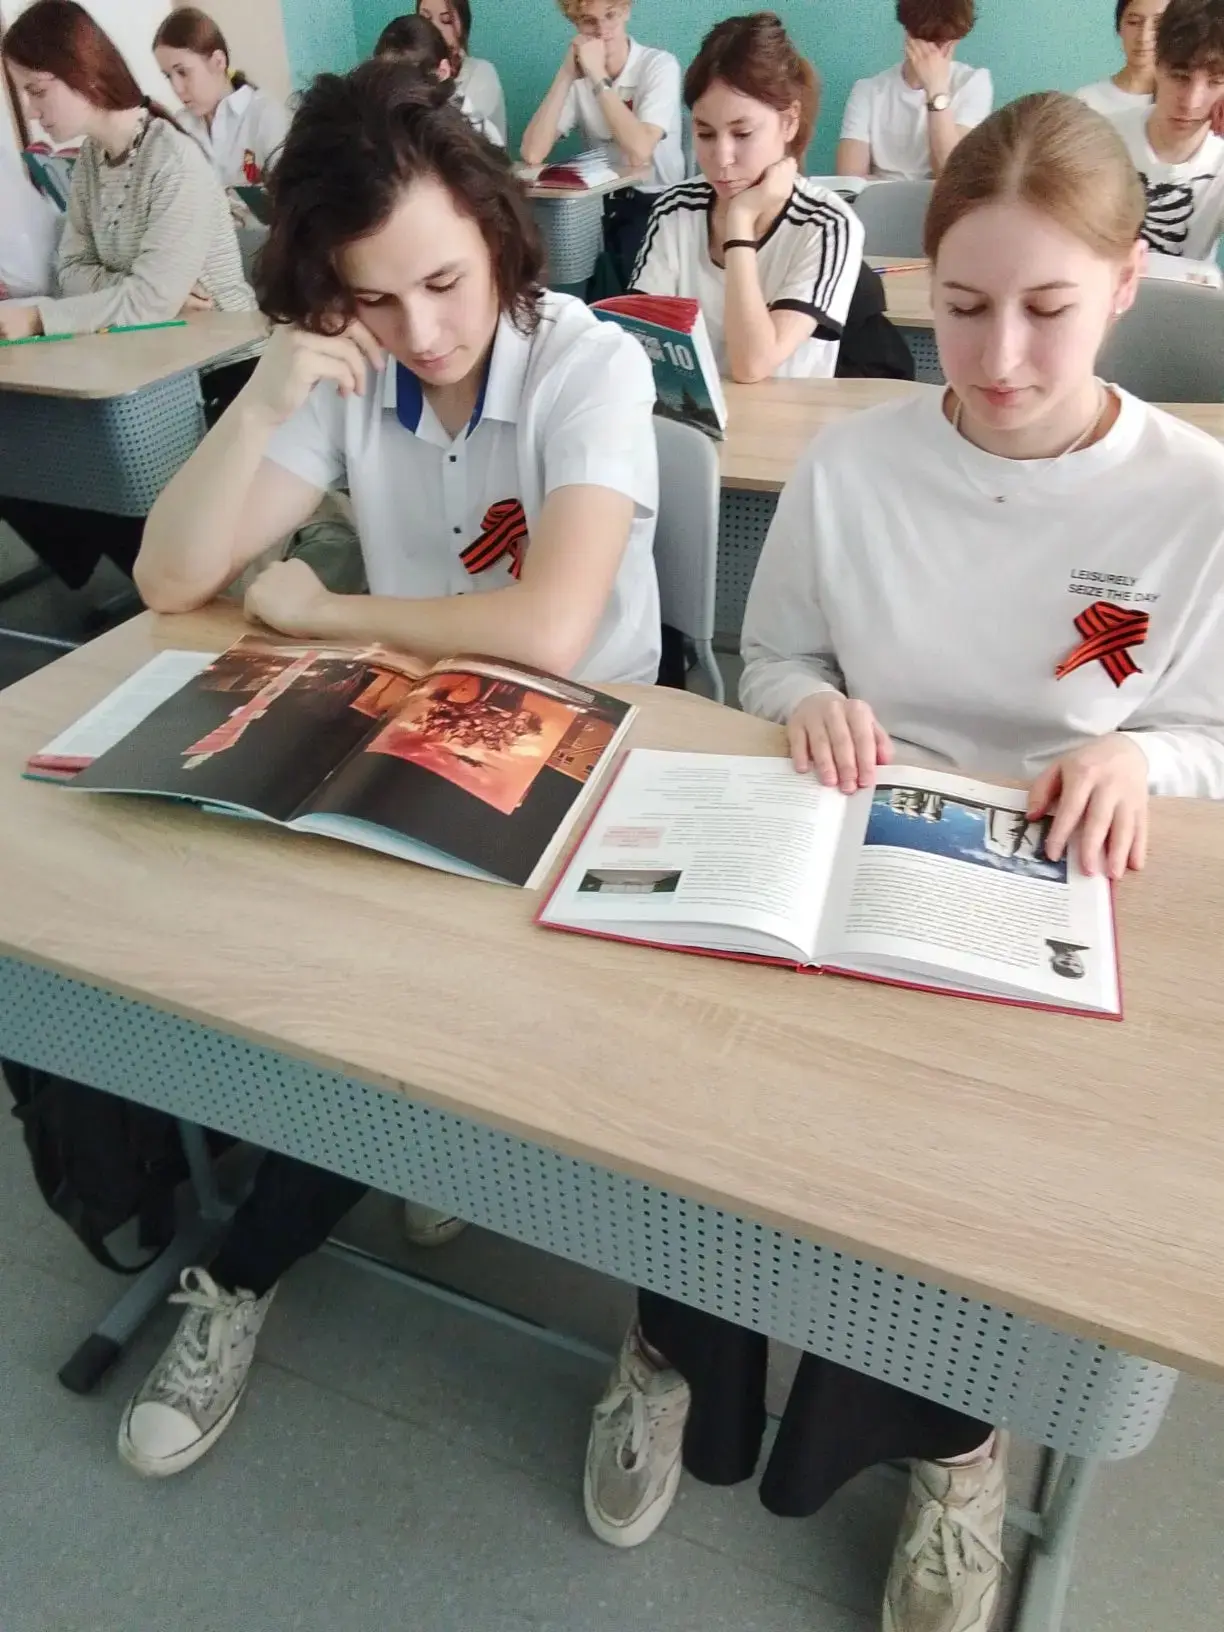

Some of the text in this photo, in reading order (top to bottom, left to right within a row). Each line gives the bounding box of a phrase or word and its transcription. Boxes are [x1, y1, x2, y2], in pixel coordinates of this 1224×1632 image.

[663, 341, 695, 371] 10
[1070, 569, 1137, 586] LEISURELY
[1068, 584, 1160, 603] SEIZE THE DAY
